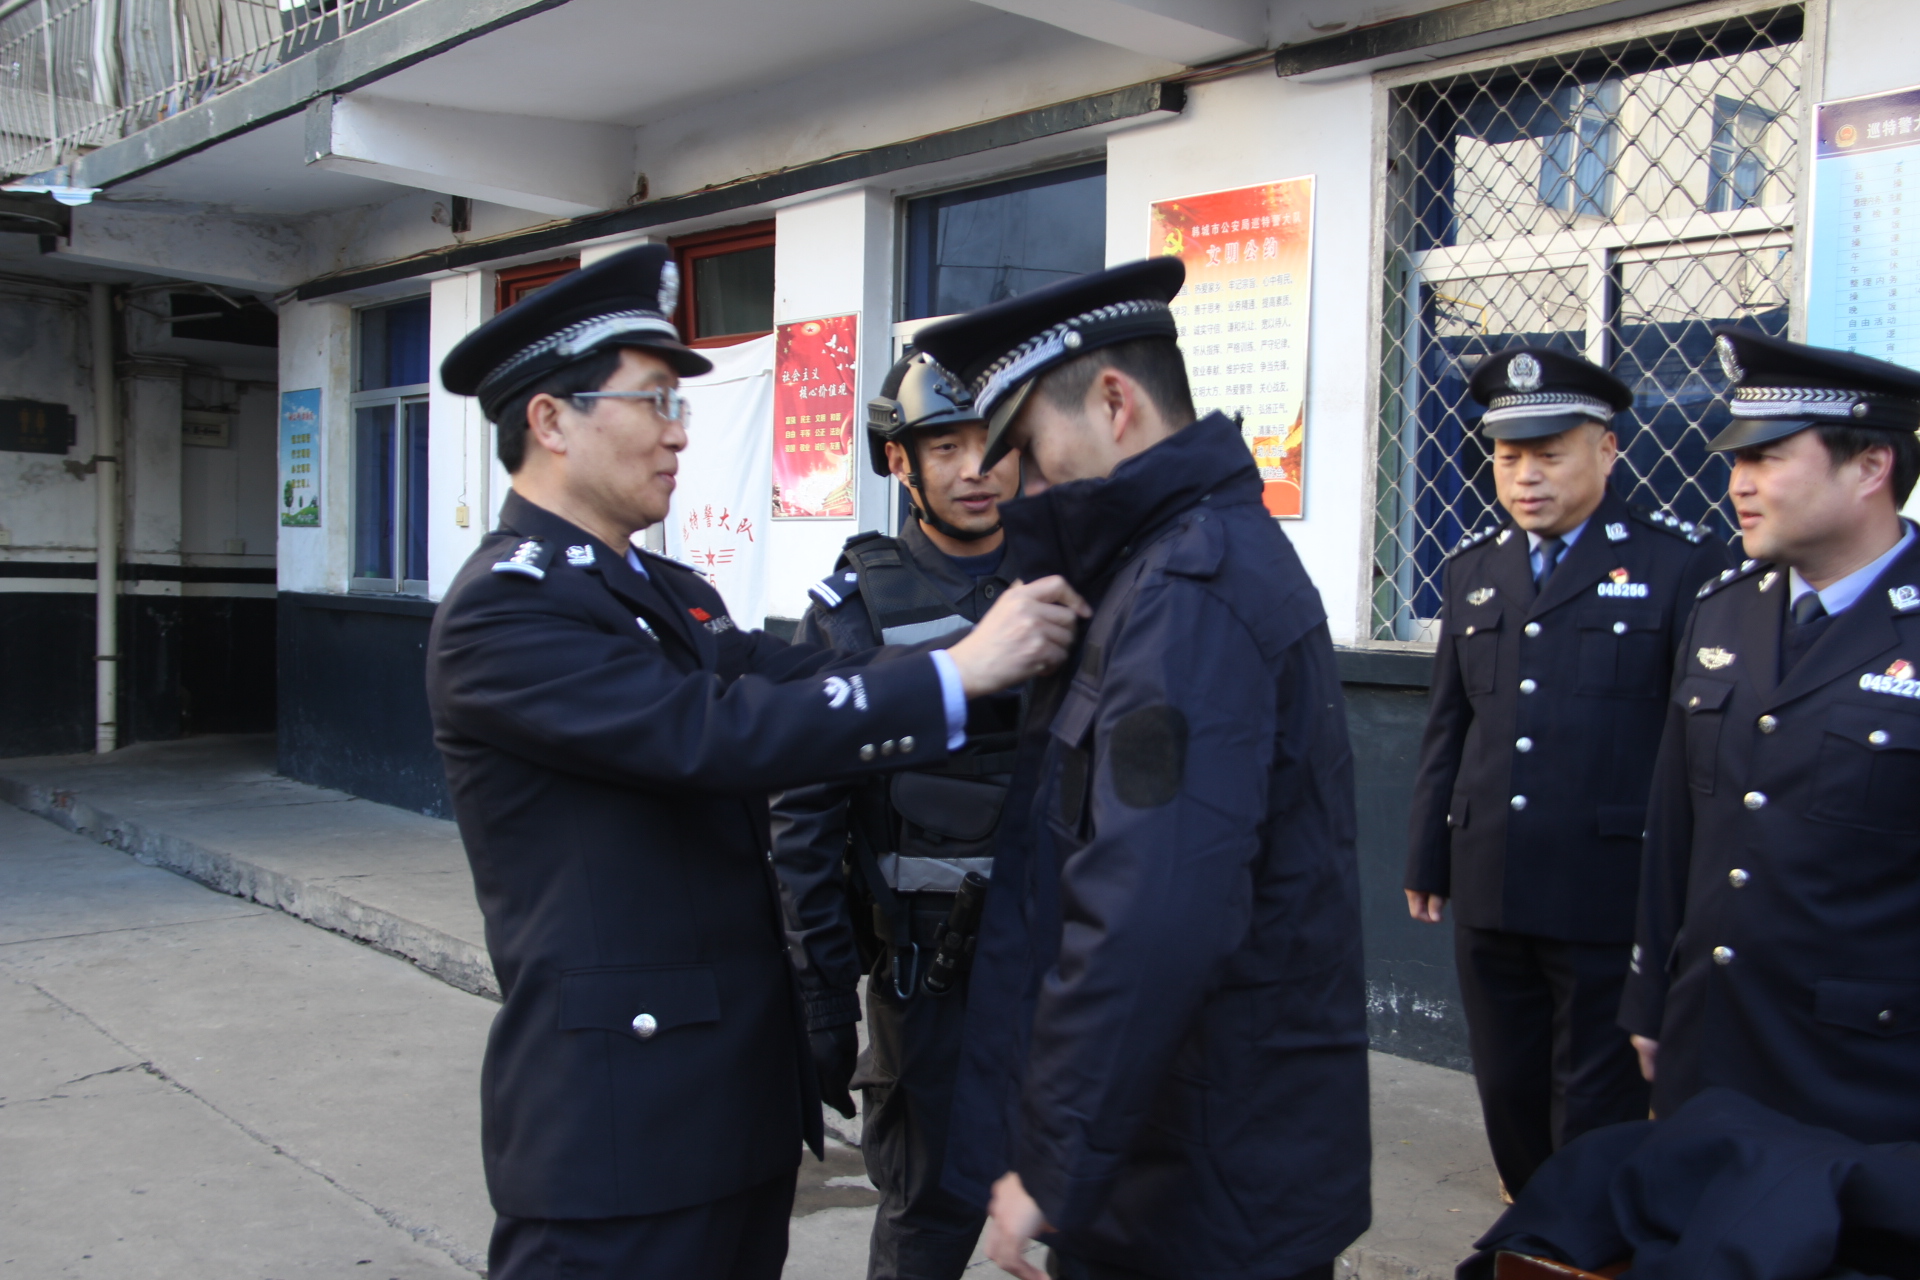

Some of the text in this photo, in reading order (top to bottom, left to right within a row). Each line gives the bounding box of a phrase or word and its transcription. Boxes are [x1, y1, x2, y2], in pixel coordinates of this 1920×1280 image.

[1191, 211, 1302, 237] 韩城市公安局巡特警大队
[1205, 236, 1278, 267] 文明公约
[1175, 273, 1293, 296] 国、热爱家乡、牢记宗旨、心中有民。
[782, 367, 820, 383] 社会主义
[799, 382, 848, 399] 核心价值观
[815, 428, 826, 437] 公正
